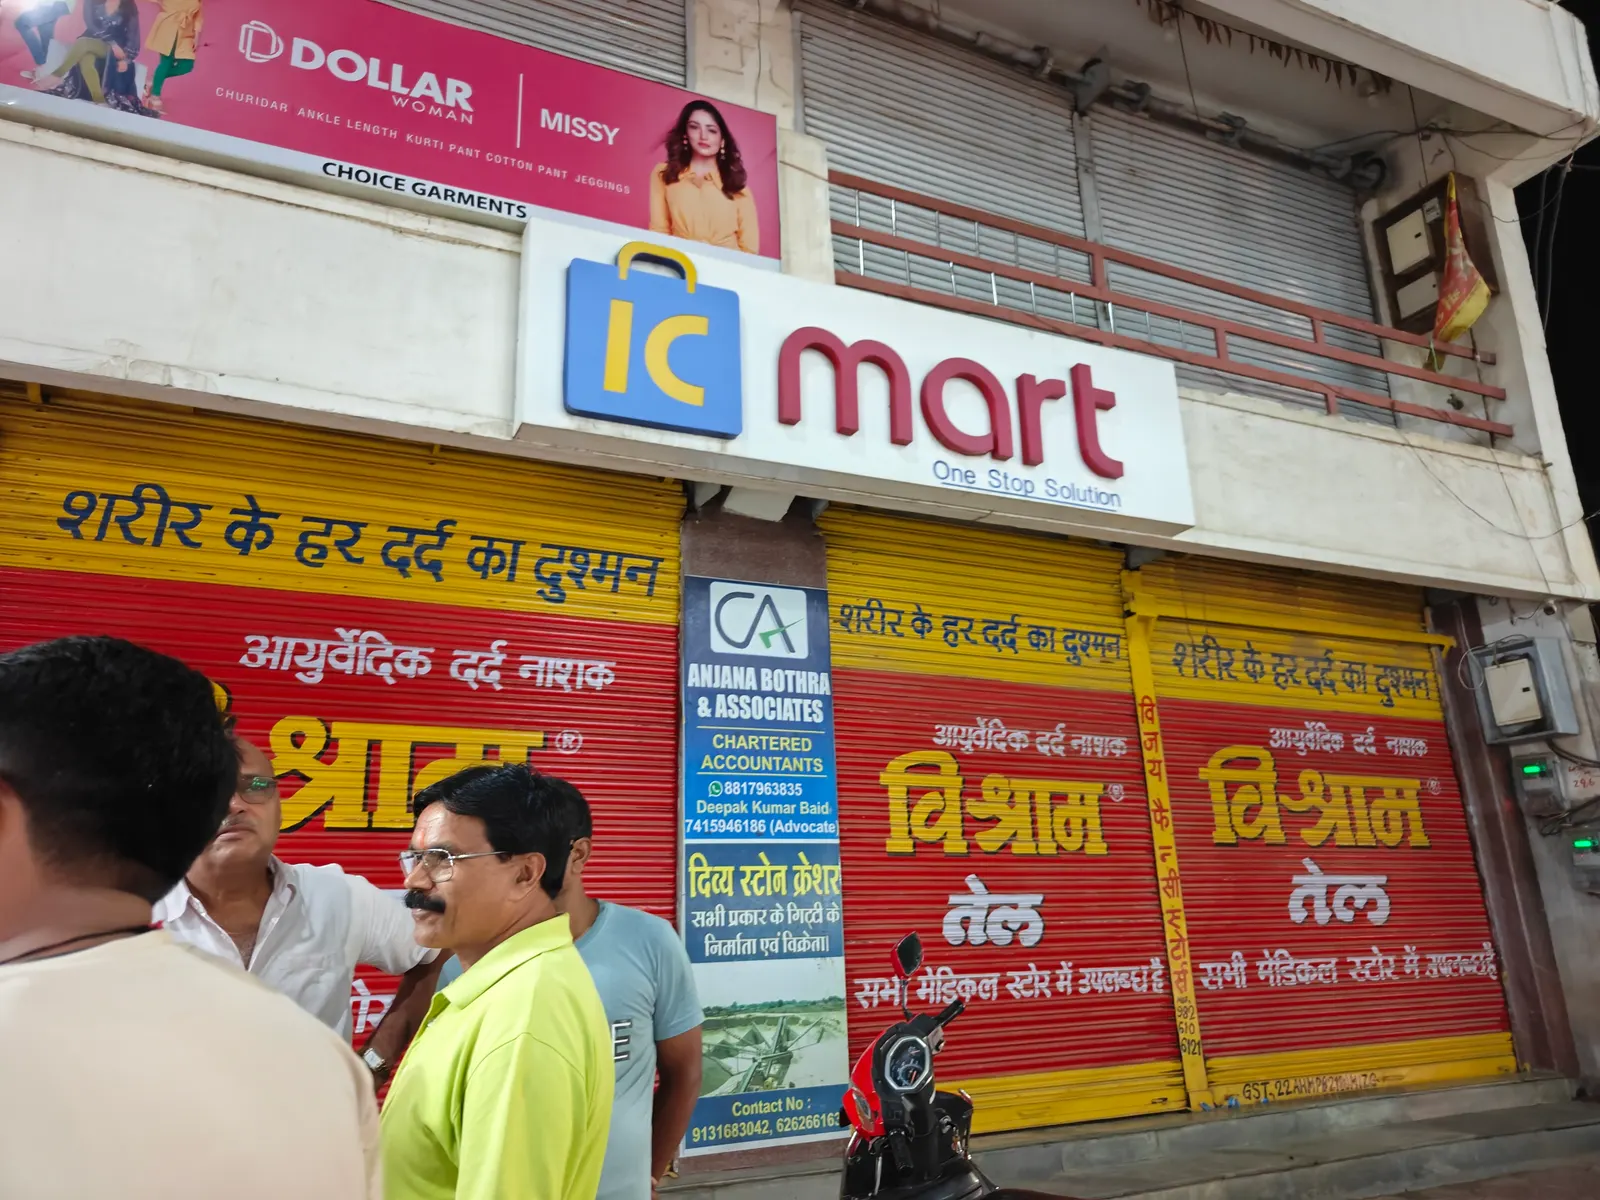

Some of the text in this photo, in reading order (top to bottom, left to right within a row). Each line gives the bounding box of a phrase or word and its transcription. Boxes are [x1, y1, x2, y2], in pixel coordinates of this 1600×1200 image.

[290, 36, 474, 112] DOLLAR
[392, 95, 473, 125] WOMAN
[540, 108, 620, 145] MISSY
[216, 87, 631, 194] CHURIDAR ANKLE LENGTH KURTI PANT COTTON PANT JEGGINGS
[322, 162, 527, 218] CHOICE GARMENTS
[603, 299, 1124, 479] IC mart
[933, 460, 1121, 507] One Stop Solution
[56, 483, 665, 604] शरीर के हर दर्द का दुश्मन
[714, 591, 796, 653] CA
[840, 598, 1122, 666] शरीर के हर दर्द का दुश्मन
[450, 640, 508, 690] दर्द
[517, 655, 616, 693] नाशक
[687, 663, 831, 695] ANJANA BOTHRA
[1171, 634, 1238, 681] शरीर
[1242, 640, 1265, 683] के
[697, 693, 824, 723] & ASSOCIATES
[712, 733, 812, 751] CHARTERED
[1035, 722, 1067, 757] दर्द
[700, 755, 823, 772] ACCOUNTANTS
[696, 800, 829, 816] Deepak Kumar Baid
[724, 781, 802, 796] 8817963835
[879, 749, 1109, 857] विश्राम
[1198, 744, 1432, 849] विश्राम
[685, 819, 839, 836] 7415946186 (Advocate)
[688, 851, 841, 898] दिव्य स्टोन क्रेशर
[1287, 857, 1391, 926] तेल
[691, 903, 726, 928] सभी
[728, 909, 767, 927] प्रकार
[770, 903, 784, 925] के
[826, 902, 840, 923] के
[942, 873, 1046, 947] तेल
[704, 932, 757, 957] निर्माता
[760, 931, 781, 956] एवं
[1199, 951, 1247, 990] सभी
[1402, 944, 1421, 979] में
[916, 966, 1001, 1005] मेडिकल
[1005, 962, 1051, 999] स्टोर
[1055, 960, 1074, 995] में
[732, 1100, 783, 1117] Contact
[785, 1096, 804, 1111] No
[776, 1112, 840, 1133] 626266163
